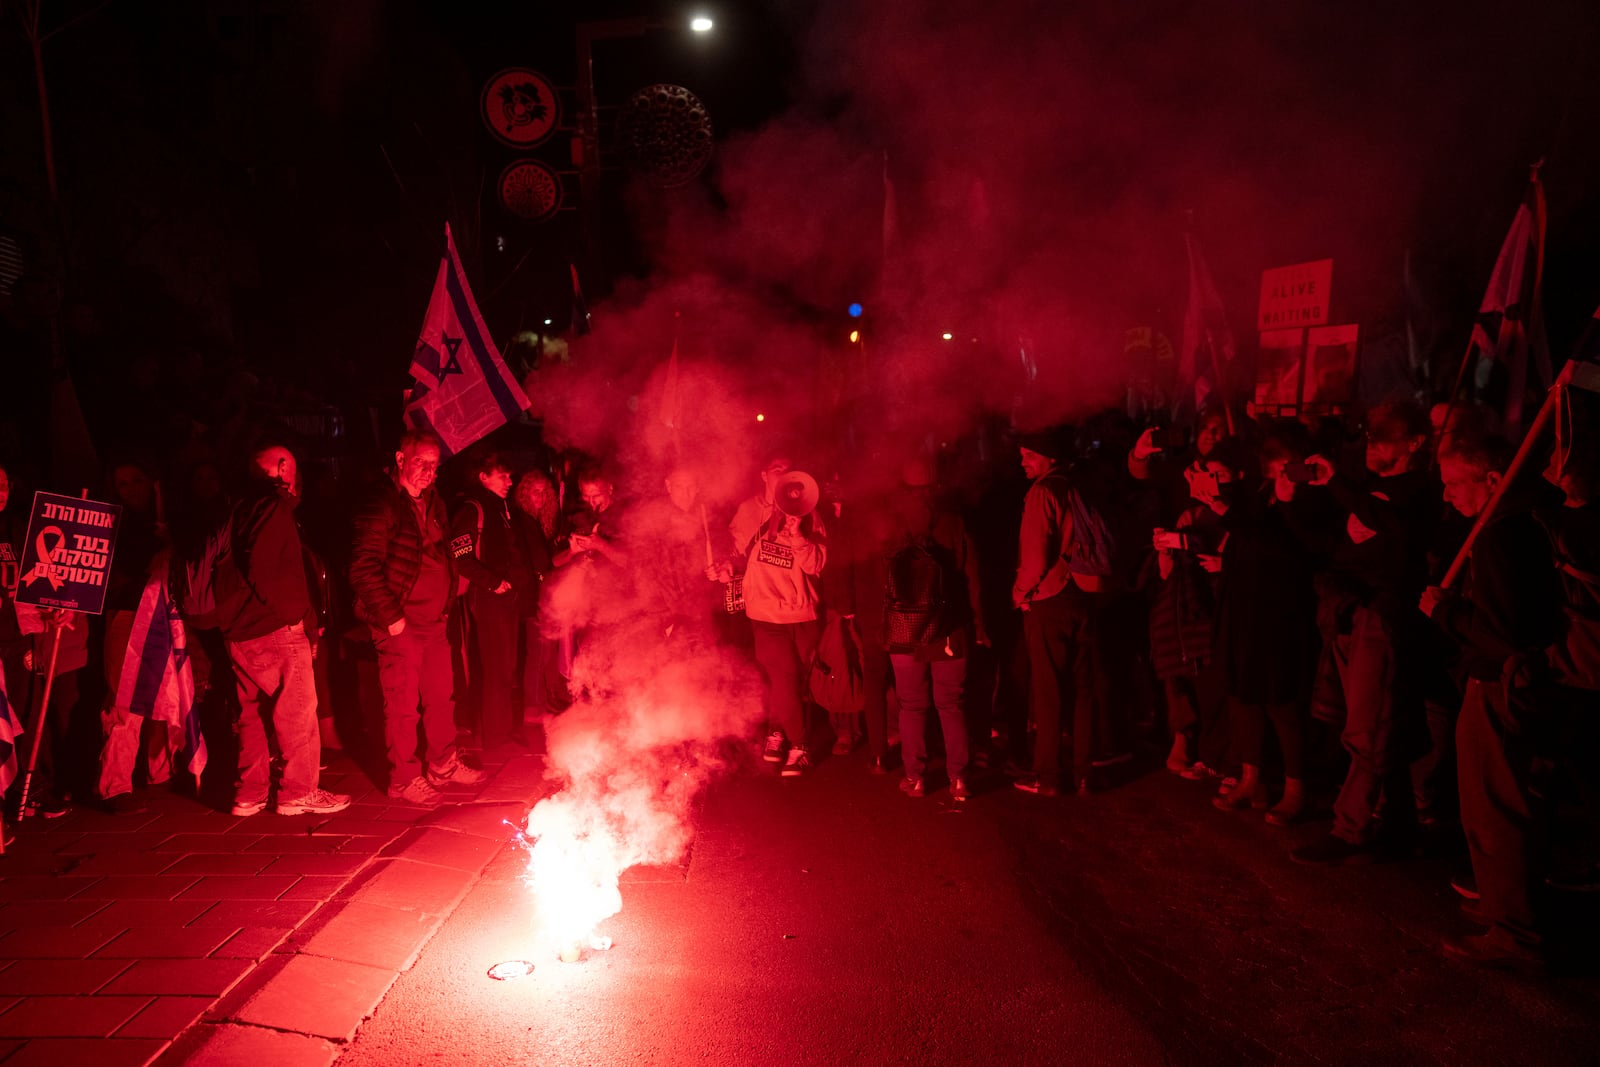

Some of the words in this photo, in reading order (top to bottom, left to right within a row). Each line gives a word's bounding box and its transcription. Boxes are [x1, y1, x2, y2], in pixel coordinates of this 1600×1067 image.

[1272, 281, 1316, 299] ALIVE
[1263, 305, 1321, 325] WAITING
[40, 502, 75, 523] הרוב
[77, 508, 116, 529] אנחנו
[72, 533, 110, 554] בעד
[51, 548, 108, 569] עסקת
[34, 562, 104, 587] חטופים
